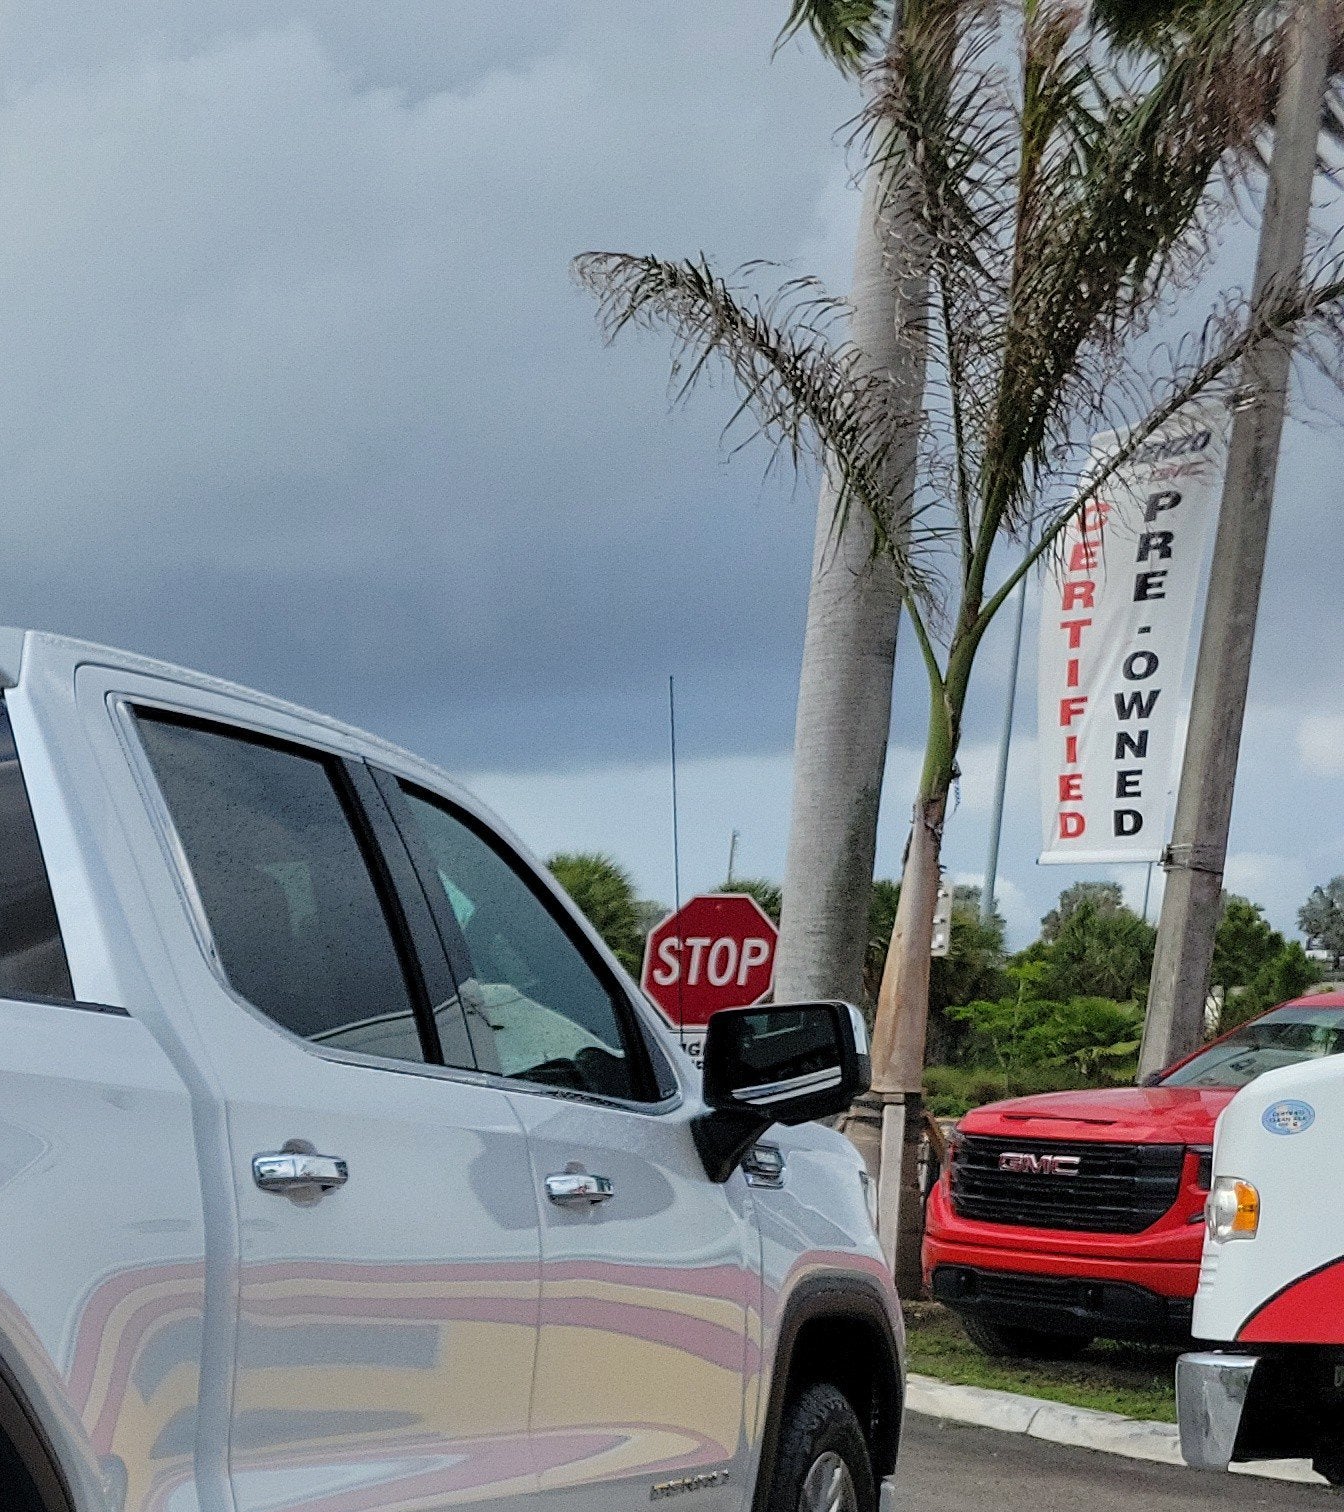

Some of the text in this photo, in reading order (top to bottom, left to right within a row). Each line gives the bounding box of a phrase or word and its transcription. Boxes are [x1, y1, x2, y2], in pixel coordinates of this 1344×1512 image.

[1058, 502, 1112, 839] CERTIFIED
[1113, 490, 1182, 837] PRE-OWNED
[652, 936, 770, 987] STOP
[998, 1151, 1081, 1177] GMC
